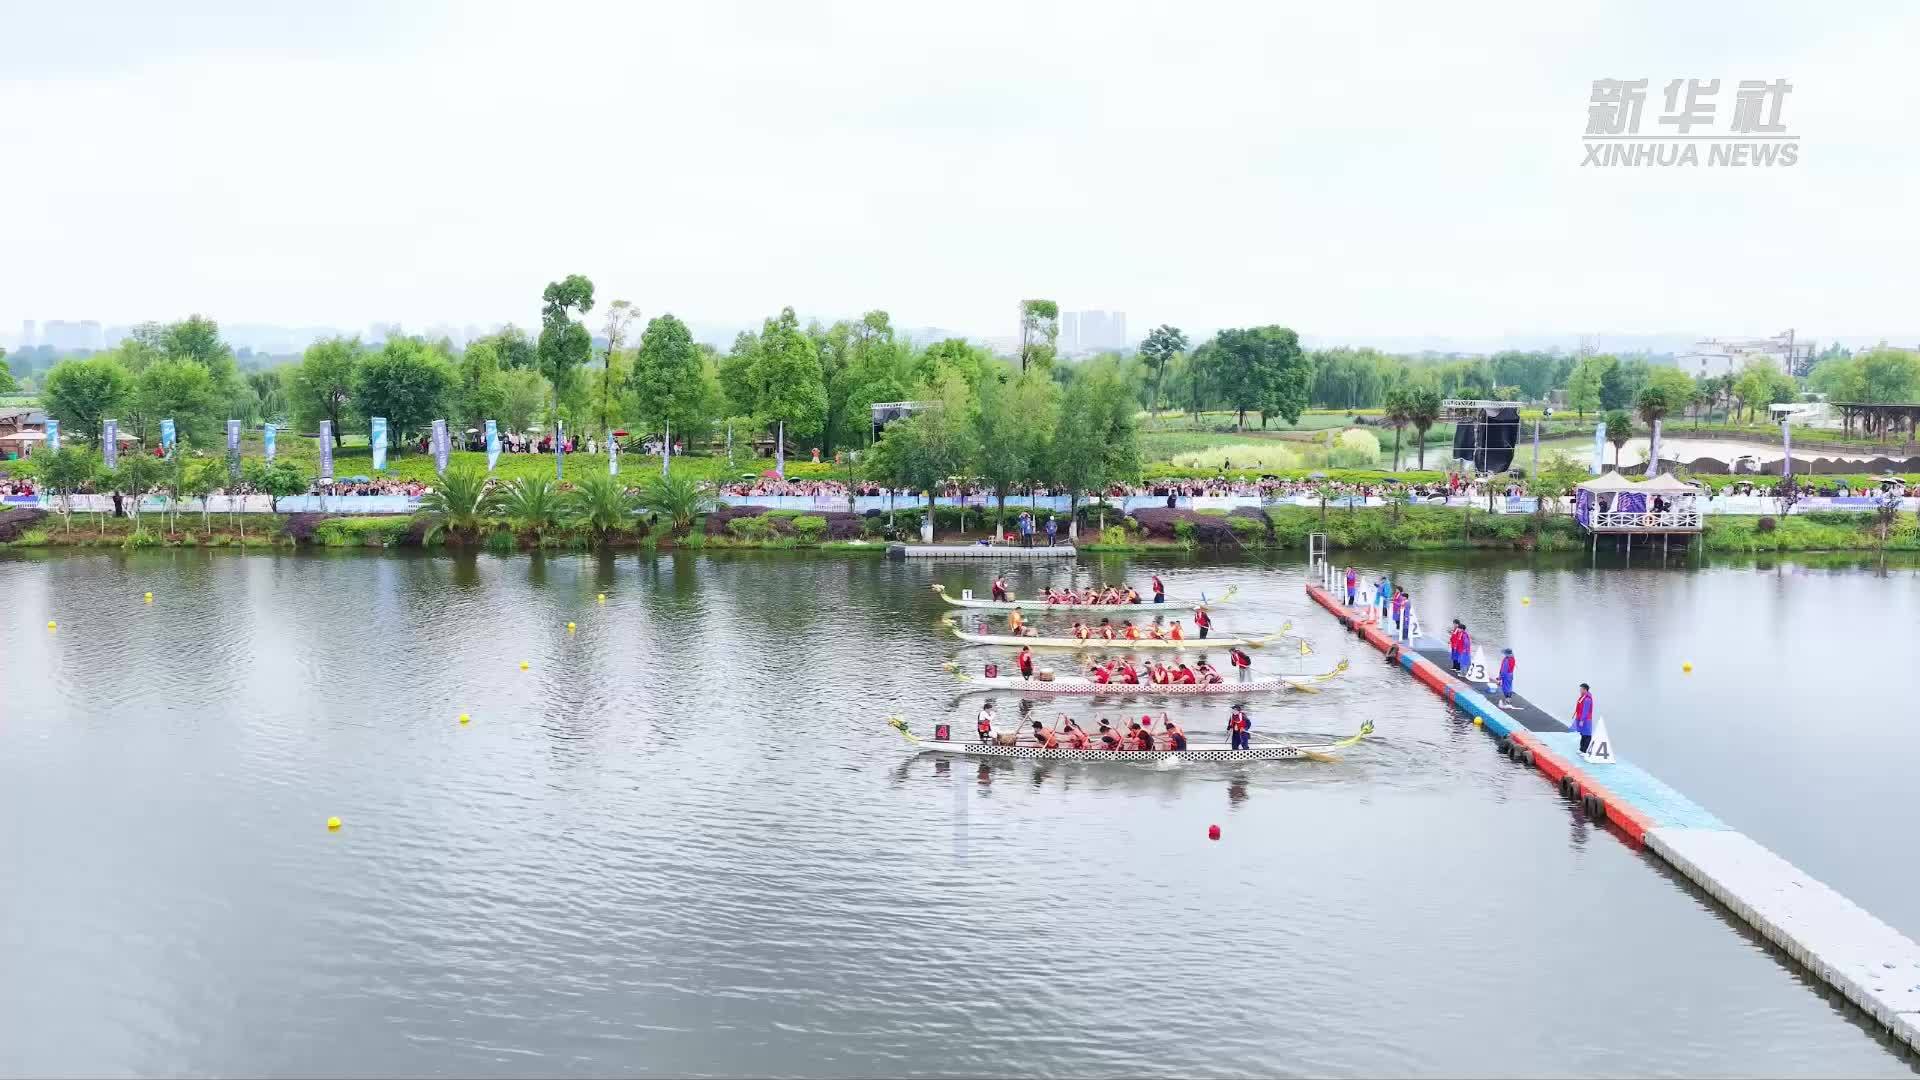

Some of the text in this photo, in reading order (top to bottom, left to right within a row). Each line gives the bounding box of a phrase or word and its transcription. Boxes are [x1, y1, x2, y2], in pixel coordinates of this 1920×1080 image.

[1361, 591, 1368, 602] 1
[1412, 623, 1418, 635] 2
[1475, 664, 1485, 679] 3
[937, 726, 948, 738] 4
[1596, 741, 1609, 760] 4
